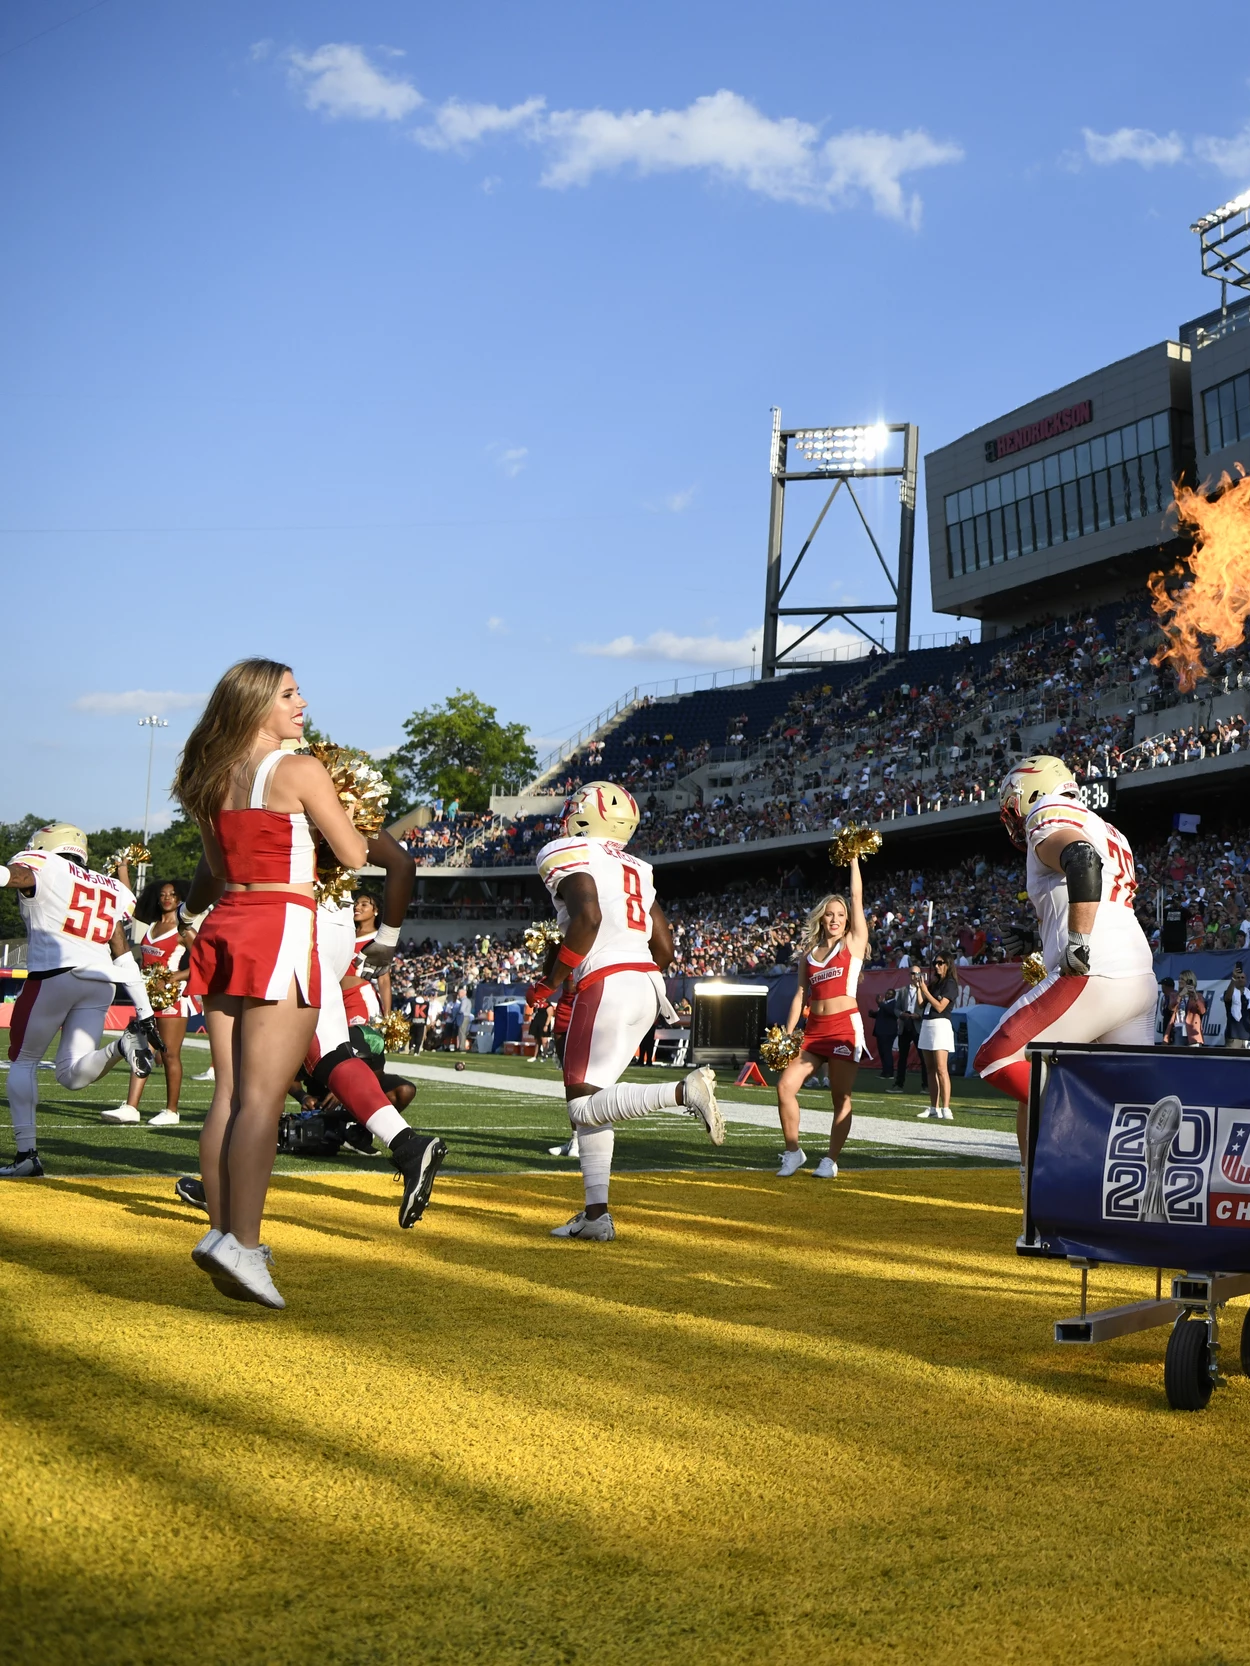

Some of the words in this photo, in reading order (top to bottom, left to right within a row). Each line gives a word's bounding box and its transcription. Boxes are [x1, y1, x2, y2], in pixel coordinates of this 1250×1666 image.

[996, 401, 1092, 460] HENDRICKSON
[68, 862, 120, 892] NEWSOME
[621, 863, 647, 932] 8
[62, 882, 117, 944] 55
